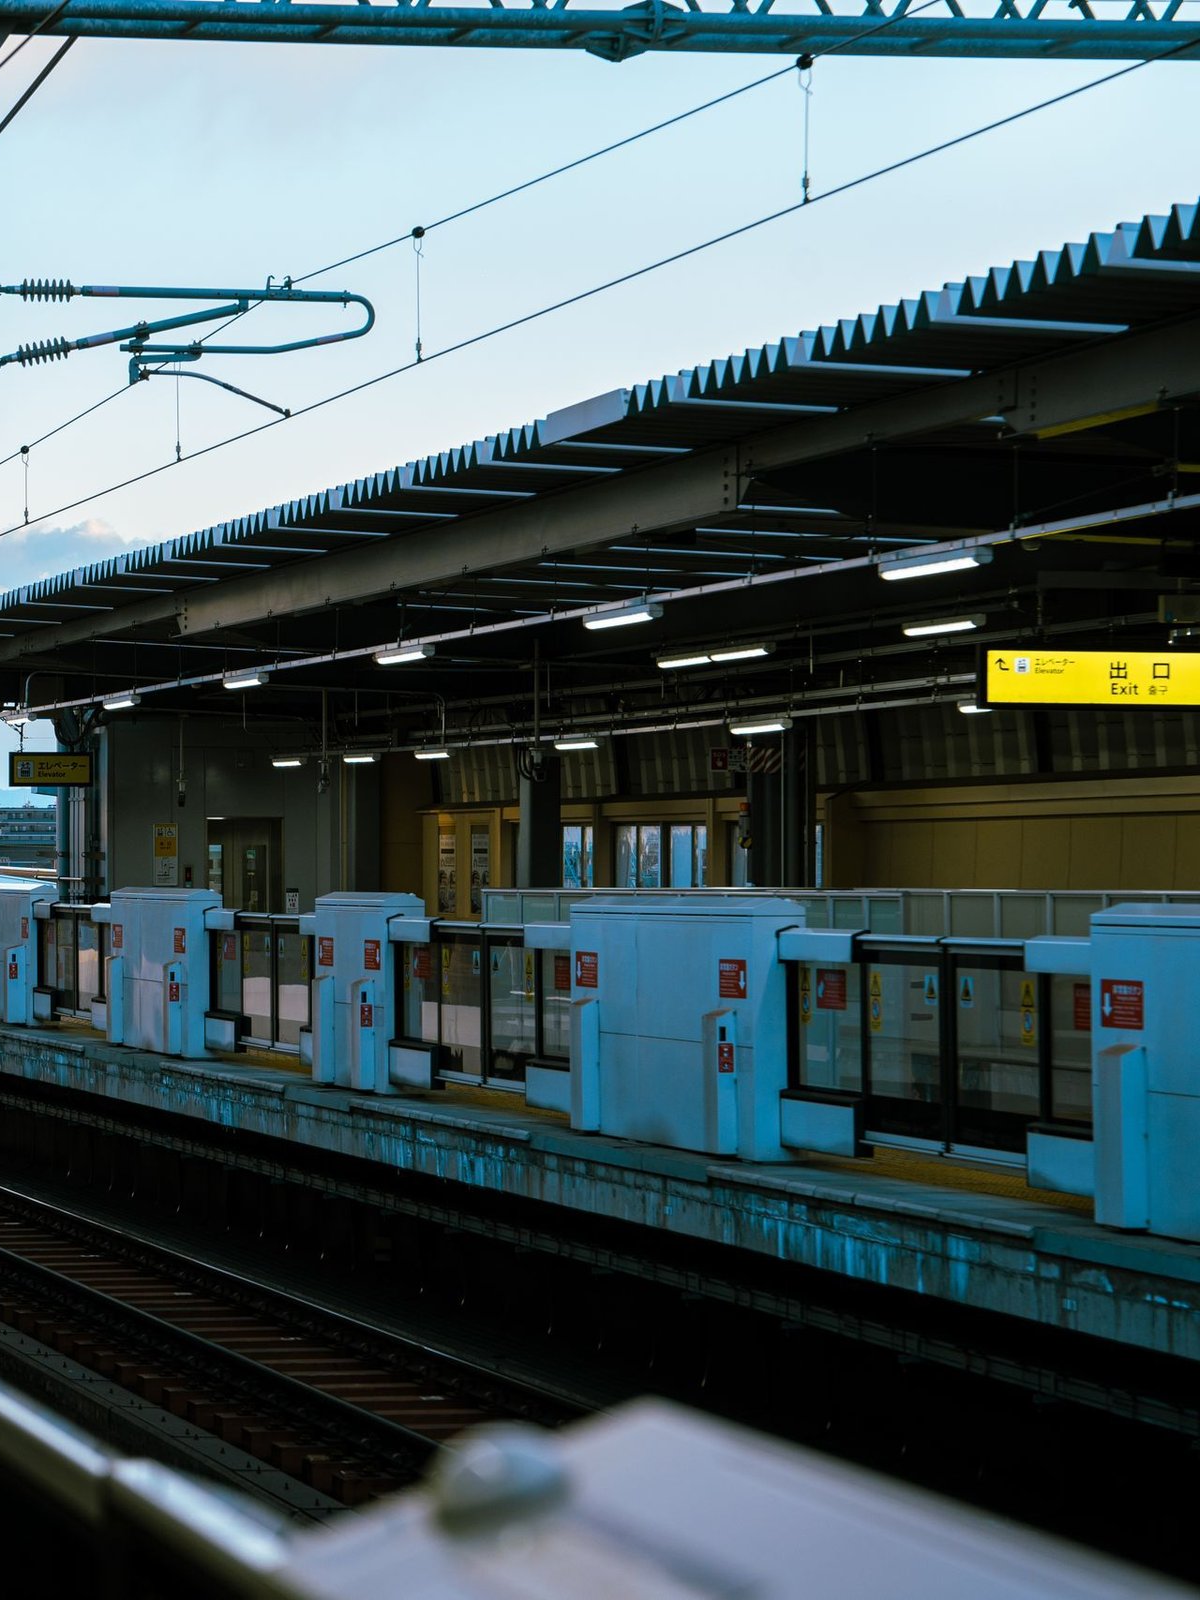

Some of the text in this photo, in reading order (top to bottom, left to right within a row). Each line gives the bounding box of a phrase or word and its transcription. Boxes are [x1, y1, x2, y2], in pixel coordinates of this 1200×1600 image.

[1034, 667, 1064, 675] Elevator
[1110, 661, 1170, 680] 出口
[1111, 683, 1138, 695] Exit
[38, 761, 87, 770] エレベーター
[38, 770, 65, 778] Elevator
